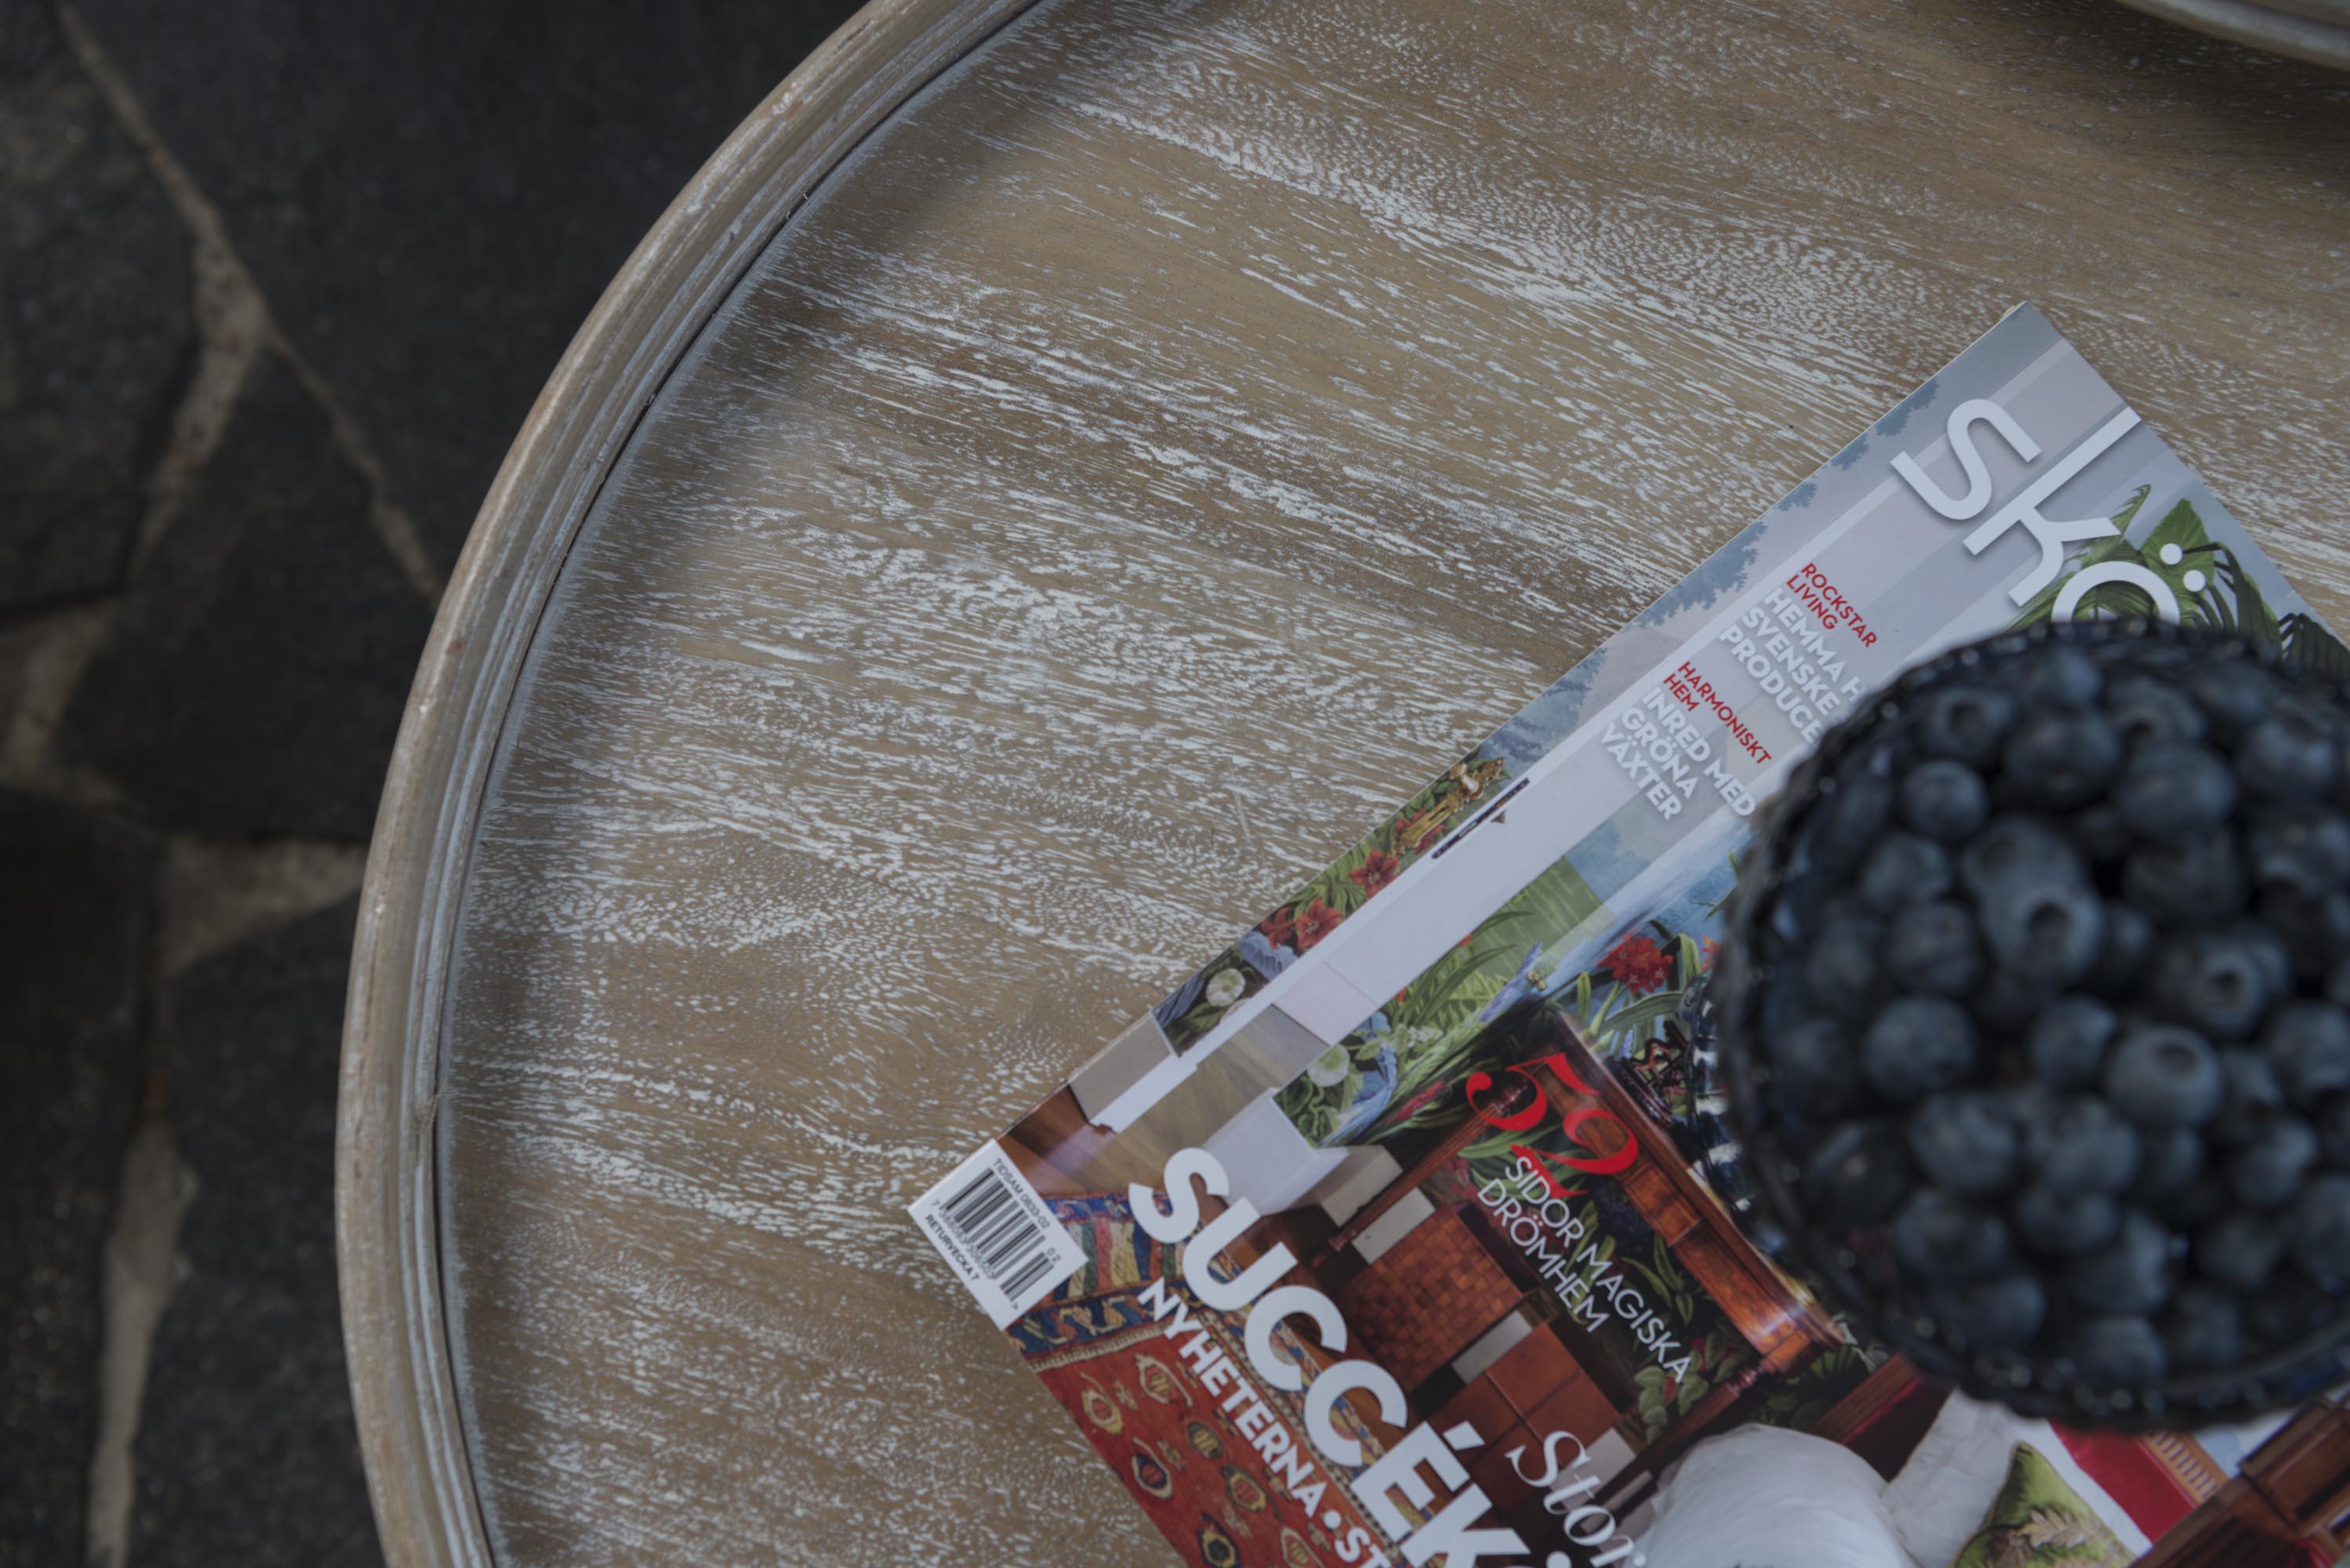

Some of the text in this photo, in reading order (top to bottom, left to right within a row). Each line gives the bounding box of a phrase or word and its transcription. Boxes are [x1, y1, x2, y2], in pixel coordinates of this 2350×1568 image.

[1763, 587, 1845, 684] HEMMA
[1786, 574, 1840, 630] LIVING
[1801, 563, 1876, 648] ROCKSTAR
[1663, 673, 1699, 711] HEM
[1678, 662, 1771, 765] HARMONISKT
[1742, 607, 1841, 715] SVENSKE
[1600, 723, 1681, 820] VÄXTER
[1622, 707, 1700, 798] GRÖNA
[1642, 687, 1756, 816] INRED MED
[1466, 1052, 1638, 1197] 52
[924, 1213, 974, 1275] RETURVECKA
[1477, 1178, 1608, 1333] DRÖMHEM
[1506, 1156, 1692, 1385] SIDOR MAGISKA
[1128, 1148, 1572, 1568] SUCCÉK
[1137, 1276, 1327, 1517] NYHETERNA
[1506, 1430, 1646, 1568] Stor
